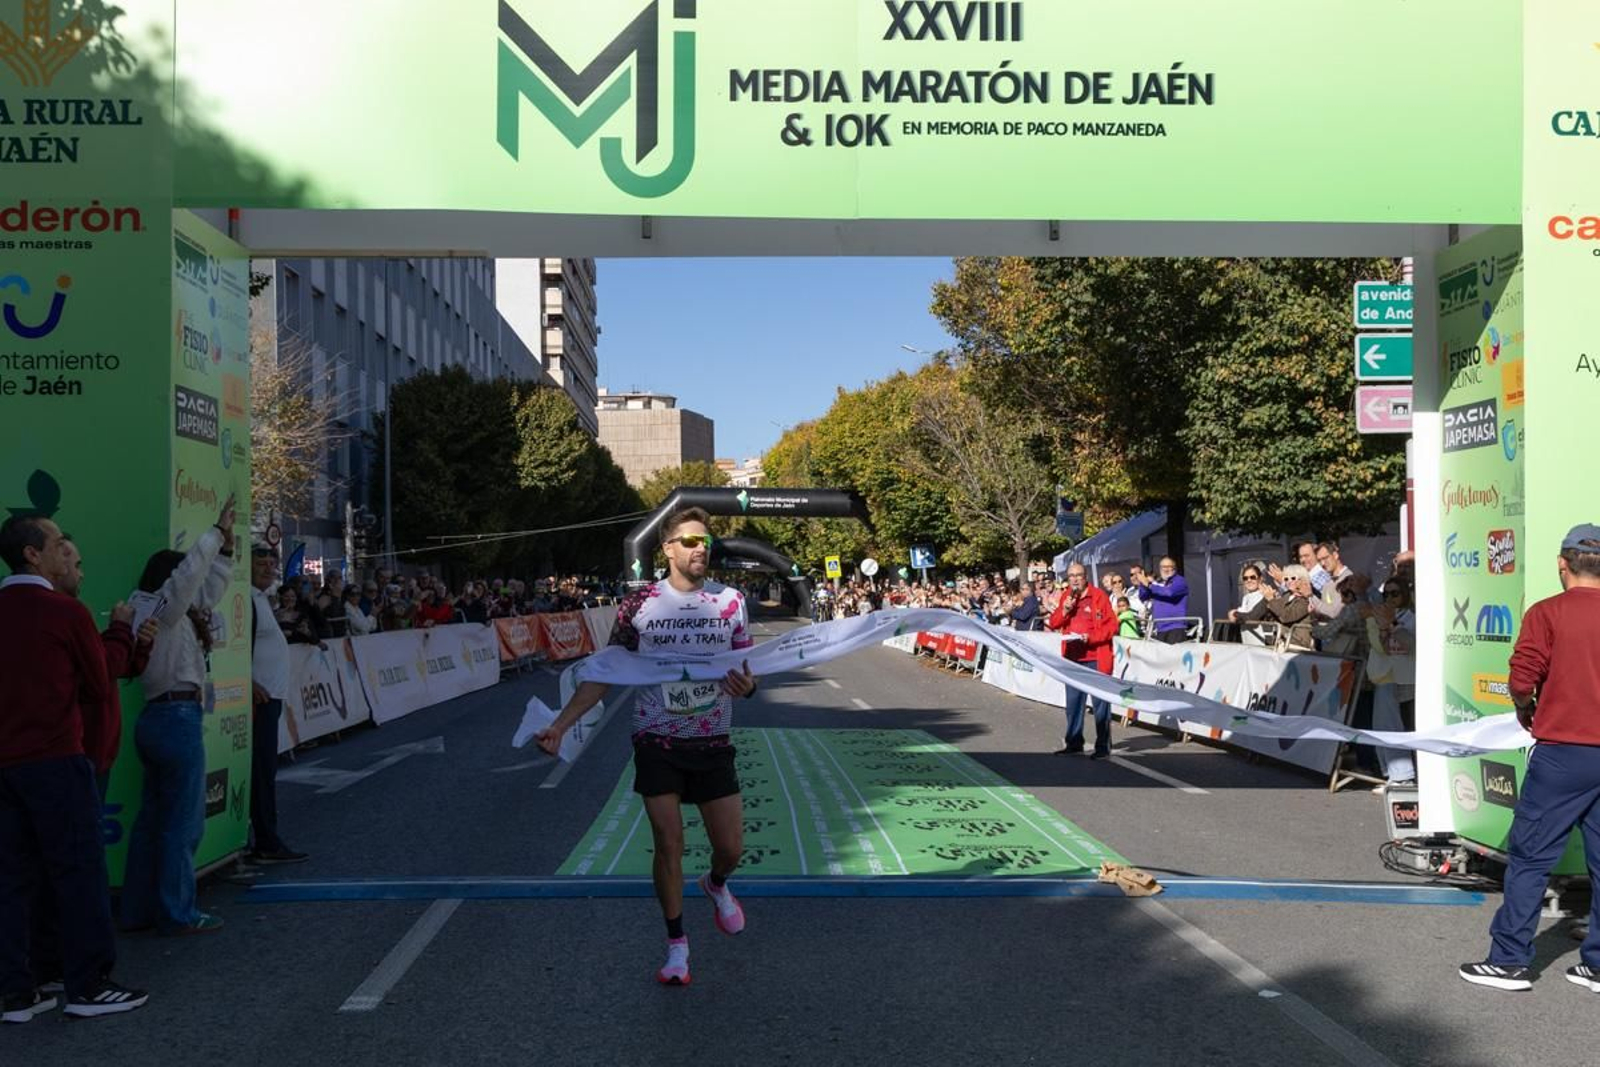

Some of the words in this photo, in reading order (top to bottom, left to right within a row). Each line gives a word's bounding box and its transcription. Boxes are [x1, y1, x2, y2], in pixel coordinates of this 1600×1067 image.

[882, 0, 1023, 42] XXVIII
[729, 68, 851, 103] MEDIA
[861, 60, 1049, 105] MARATÓN
[1064, 71, 1113, 105] DE
[1121, 62, 1214, 106] JAÉN
[23, 99, 143, 125] RURAL
[1551, 110, 1600, 137] CA
[780, 113, 813, 147] &
[902, 121, 922, 136] EN
[927, 121, 998, 137] MEMORIA
[1003, 122, 1023, 136] DE
[1027, 122, 1068, 137] PACO
[1072, 123, 1167, 138] MANZANEDA
[20, 240, 93, 250] maestras
[1361, 288, 1413, 301] avenid
[1361, 307, 1379, 320] de
[183, 325, 208, 355] FISIO
[1450, 345, 1481, 372] FISIO
[0, 373, 17, 395] e
[23, 374, 82, 396] Jaén
[1451, 366, 1483, 390] CLINIC
[176, 391, 217, 417] DACIA
[1444, 405, 1495, 428] DACIA
[177, 412, 217, 439] JAPEMASA
[1444, 422, 1497, 449] JAPEMASA
[645, 618, 732, 630] ANTIGRUPETA
[653, 634, 676, 645] RUN
[680, 634, 691, 645] &
[695, 633, 726, 645] TRAIL
[693, 683, 716, 697] 624
